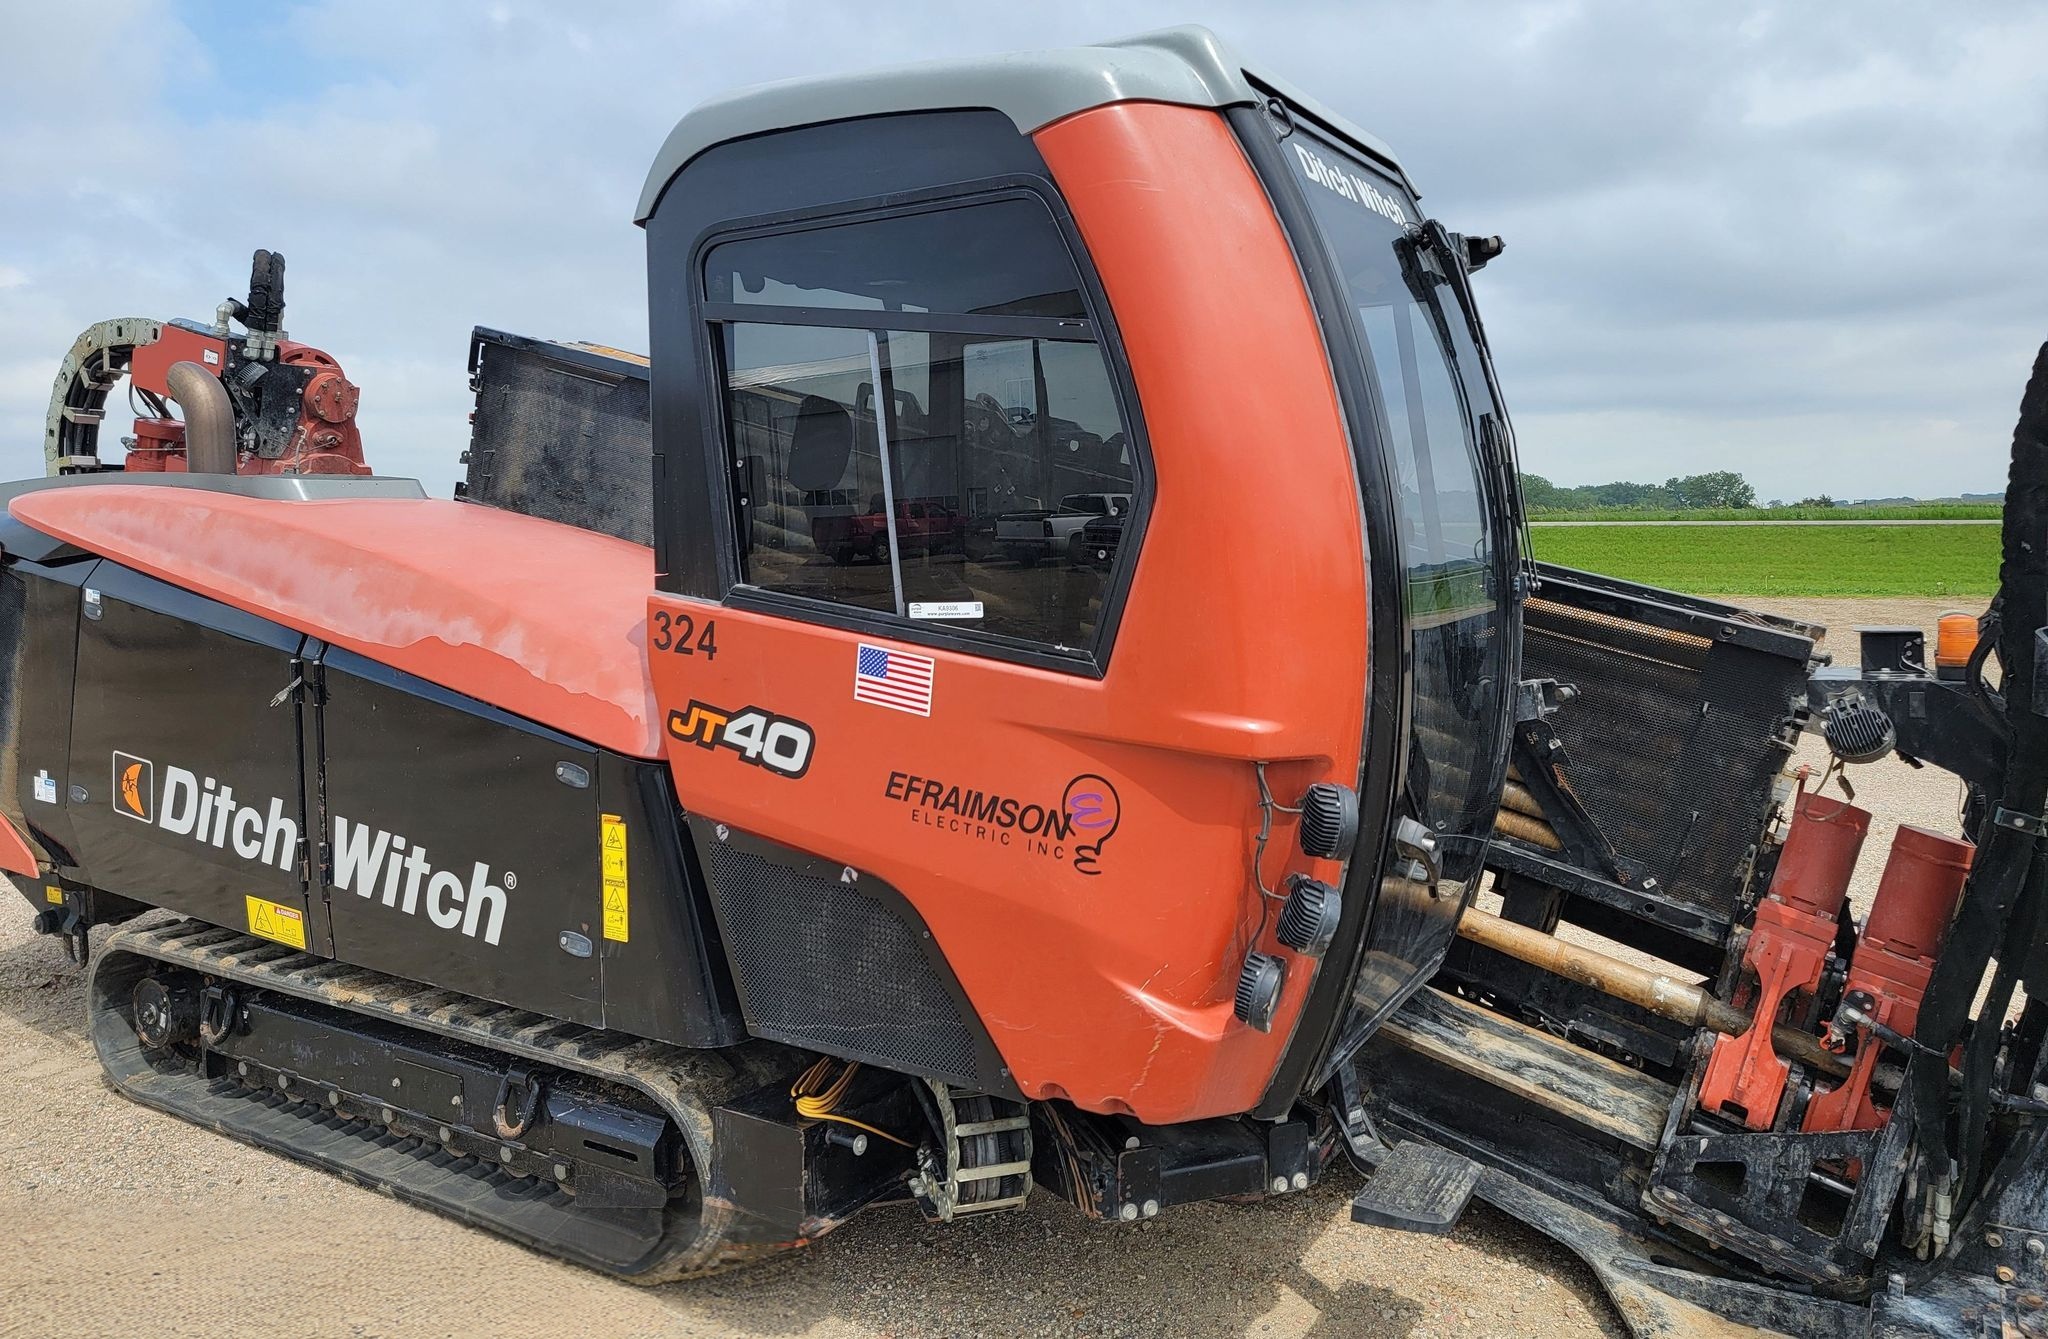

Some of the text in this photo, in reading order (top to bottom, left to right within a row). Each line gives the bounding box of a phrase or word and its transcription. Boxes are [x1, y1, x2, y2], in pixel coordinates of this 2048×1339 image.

[1293, 142, 1359, 203] Ditch
[653, 610, 718, 661] 324
[671, 706, 812, 773] JT40
[159, 764, 298, 872] Ditch
[884, 770, 1075, 841] EFRAIMSON
[911, 809, 1064, 860] ELECTRIC INC
